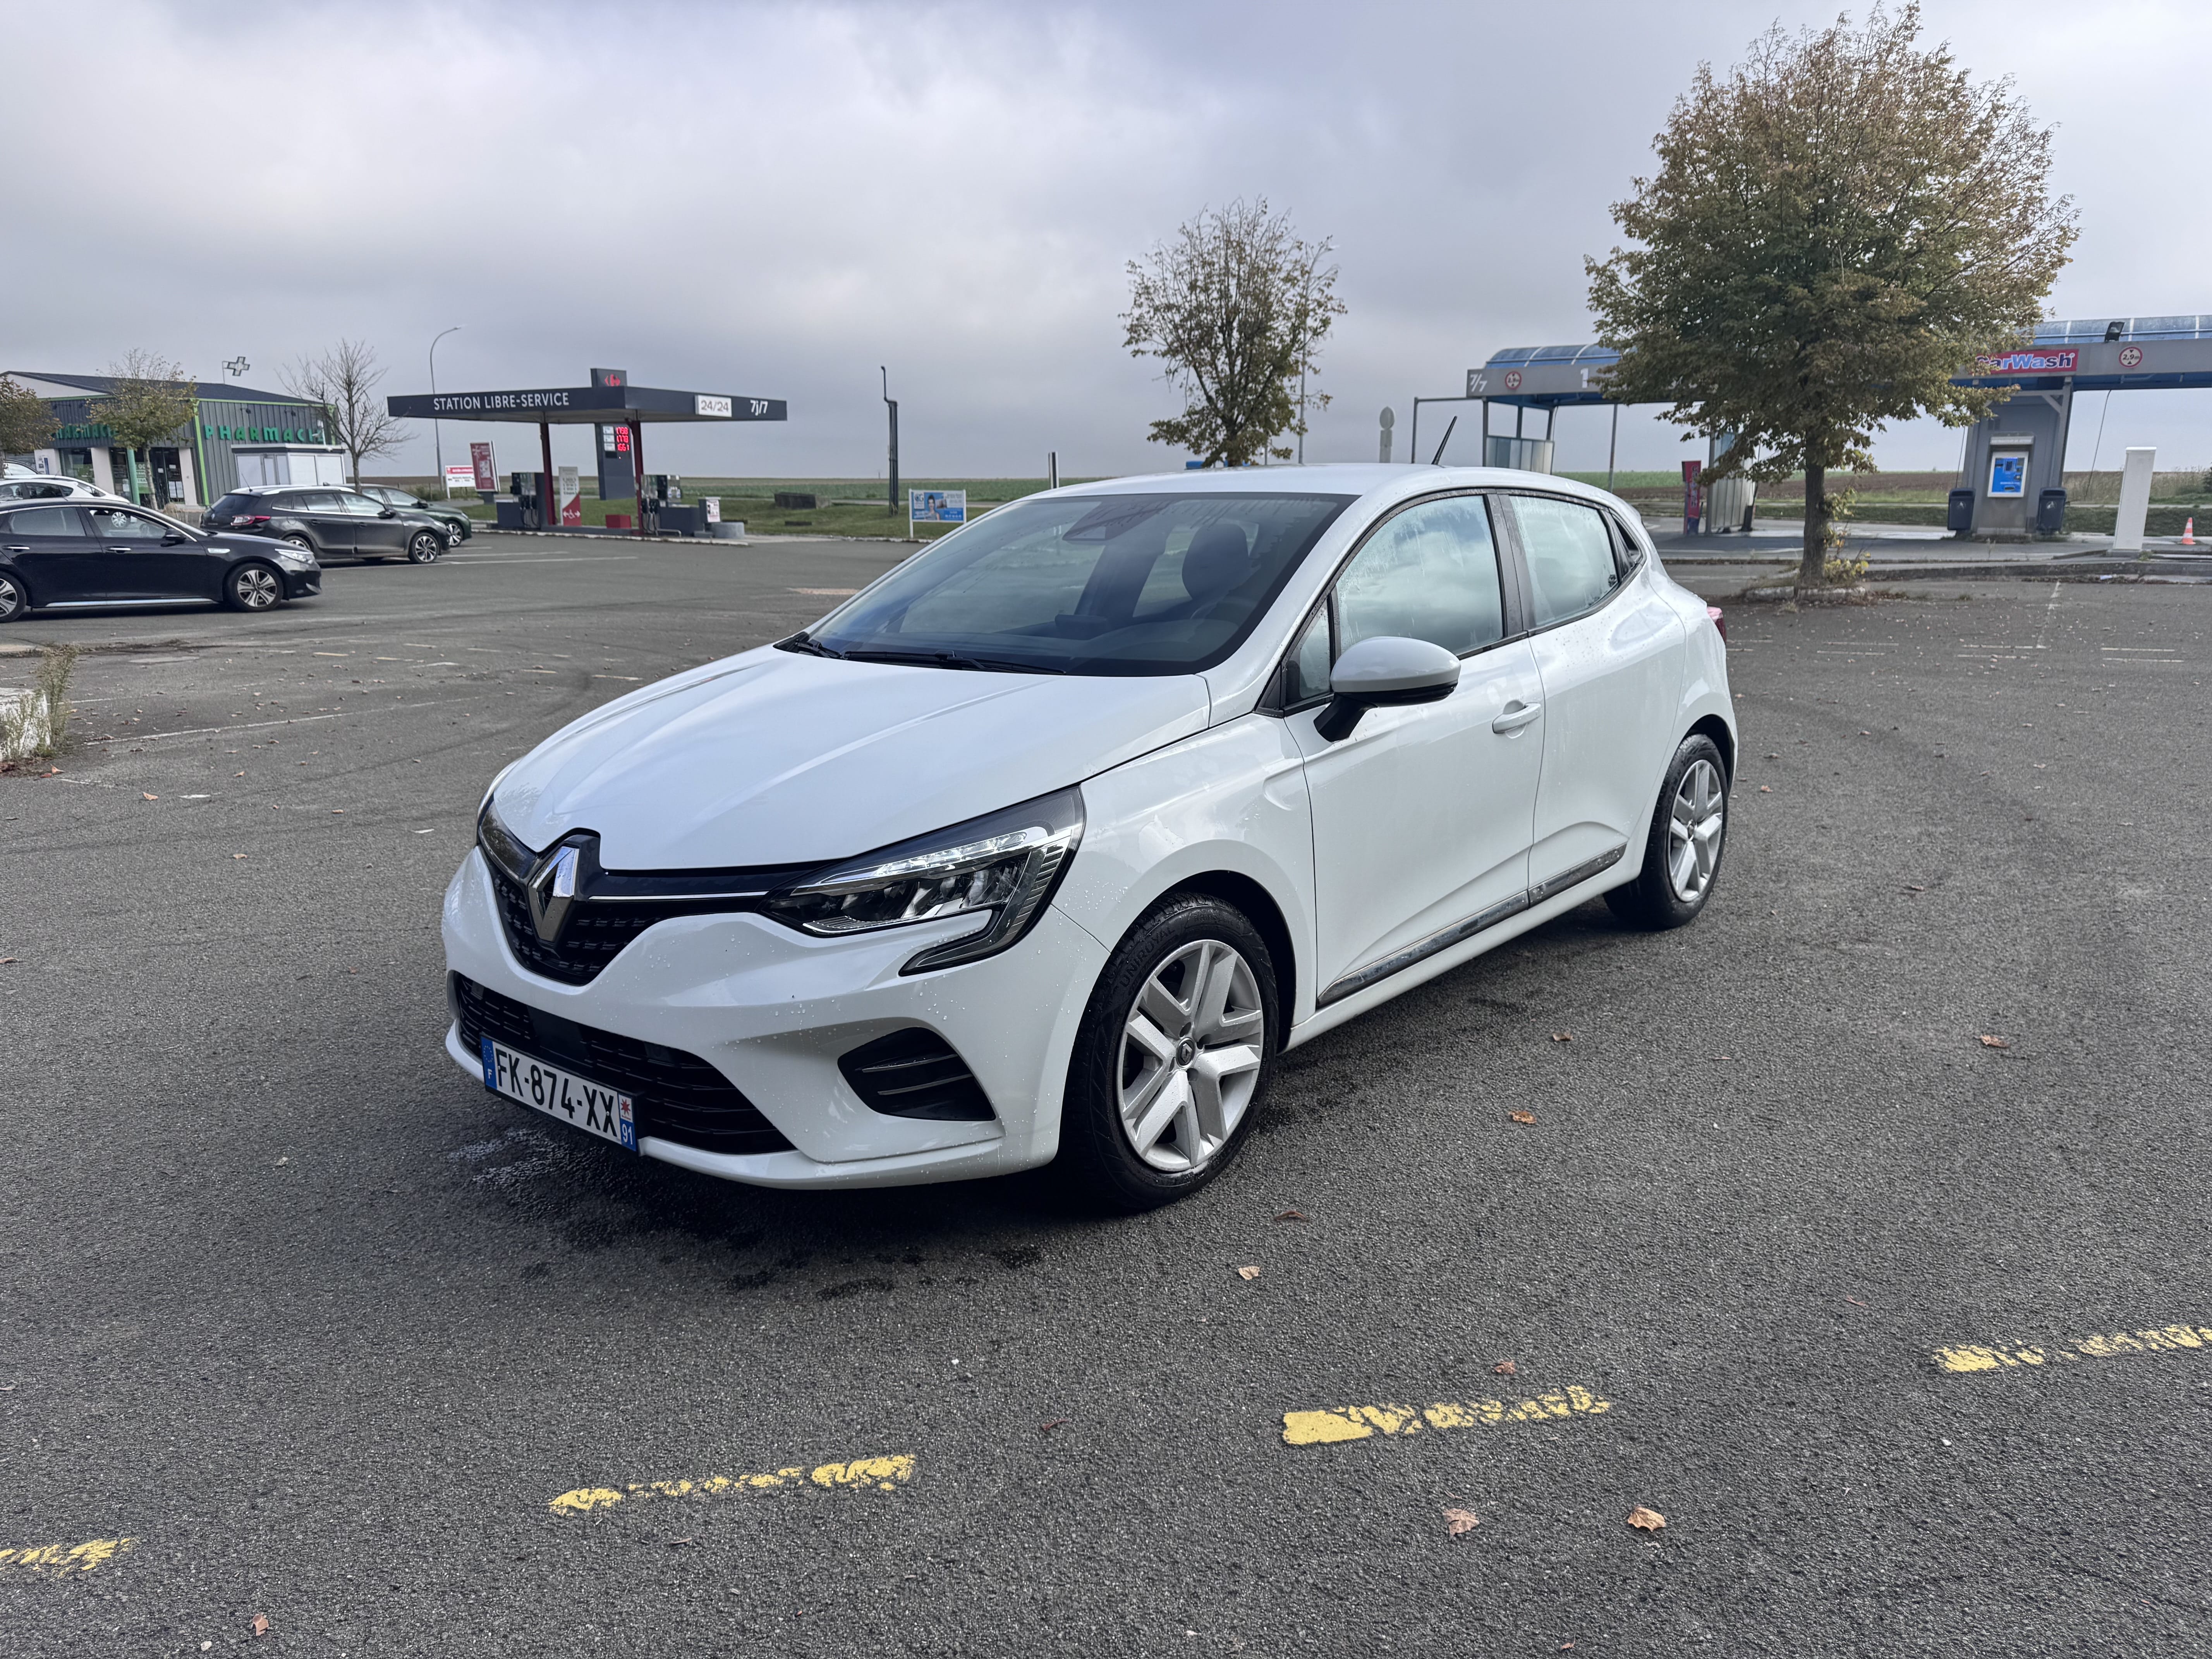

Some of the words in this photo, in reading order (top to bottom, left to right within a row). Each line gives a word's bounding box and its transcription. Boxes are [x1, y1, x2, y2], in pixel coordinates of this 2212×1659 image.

[1470, 374, 1487, 392] 7/7
[433, 397, 481, 410] STATION
[484, 392, 569, 409] LIBRE-SERVICE
[701, 400, 729, 412] 24/24
[750, 400, 768, 416] 7j/7
[1120, 926, 1176, 988] UNIROYAL
[488, 1069, 493, 1079] F
[495, 1048, 618, 1137] FK-874-XX
[622, 1123, 633, 1145] 91
